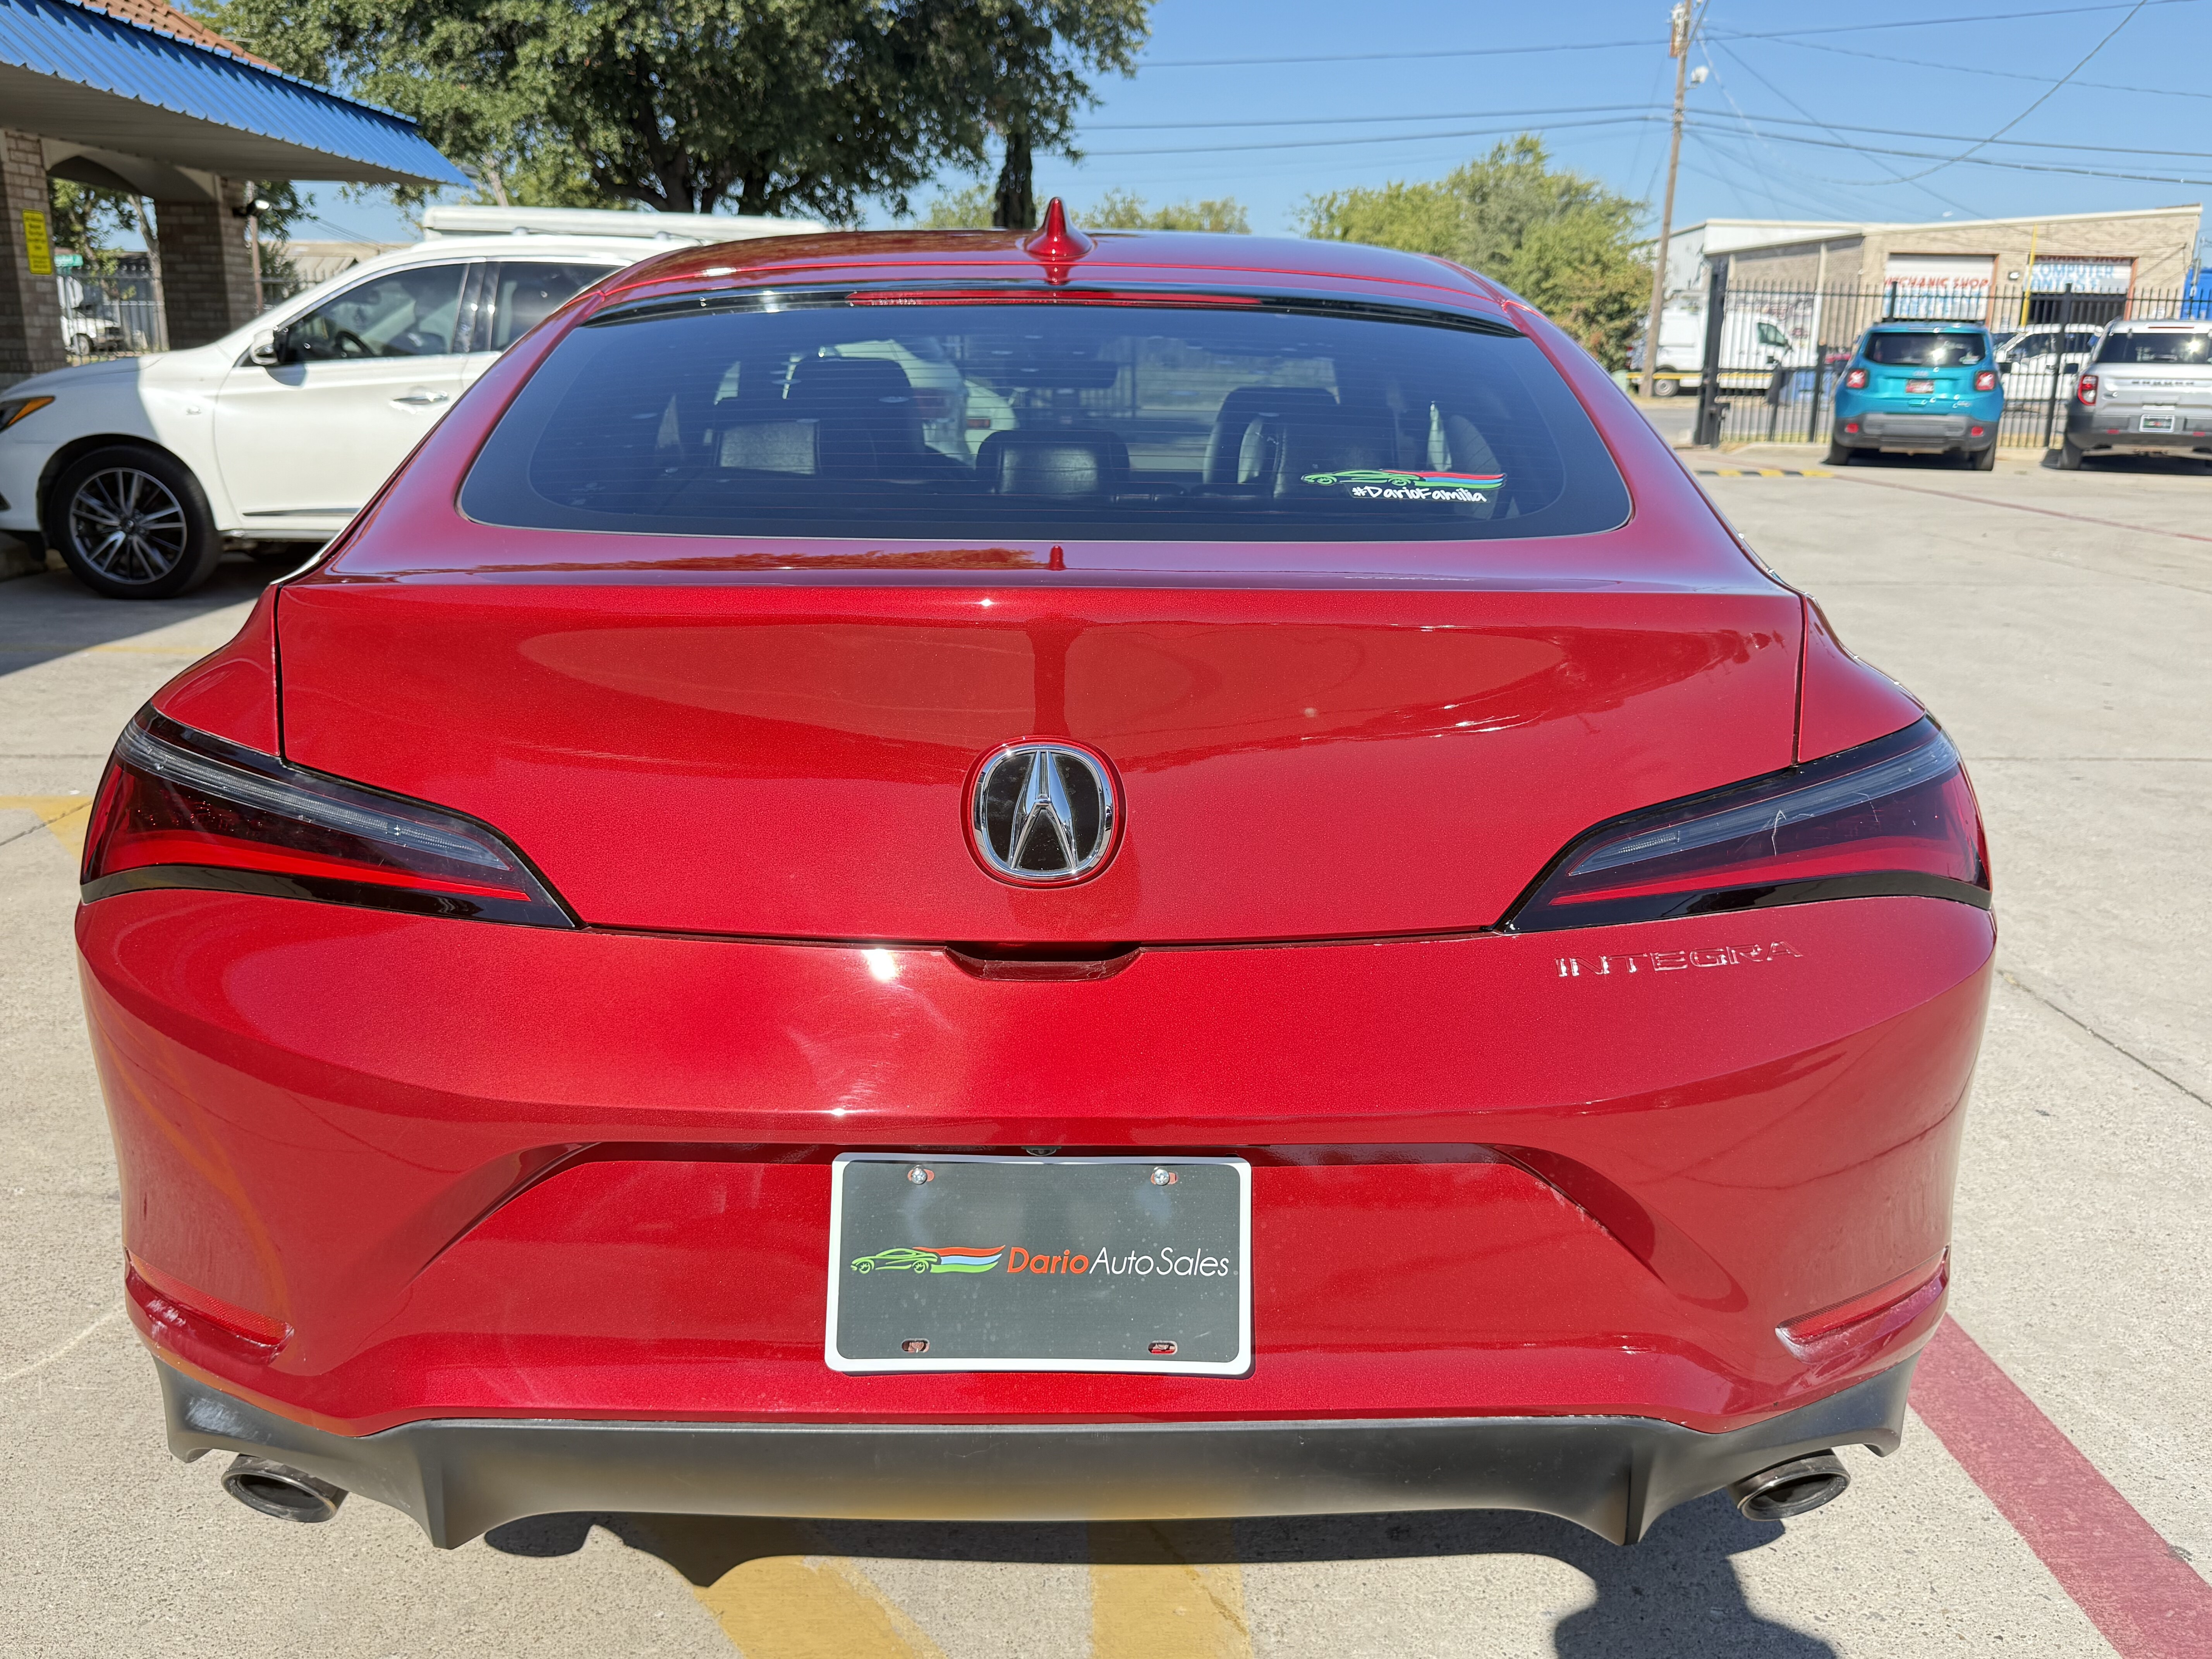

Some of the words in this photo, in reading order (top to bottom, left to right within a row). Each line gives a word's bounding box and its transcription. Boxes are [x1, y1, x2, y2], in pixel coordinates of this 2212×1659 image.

[1953, 277, 1989, 289] SHOP
[1352, 485, 1487, 502] #DarioFamilia
[1554, 941, 1803, 977] INTEGRA
